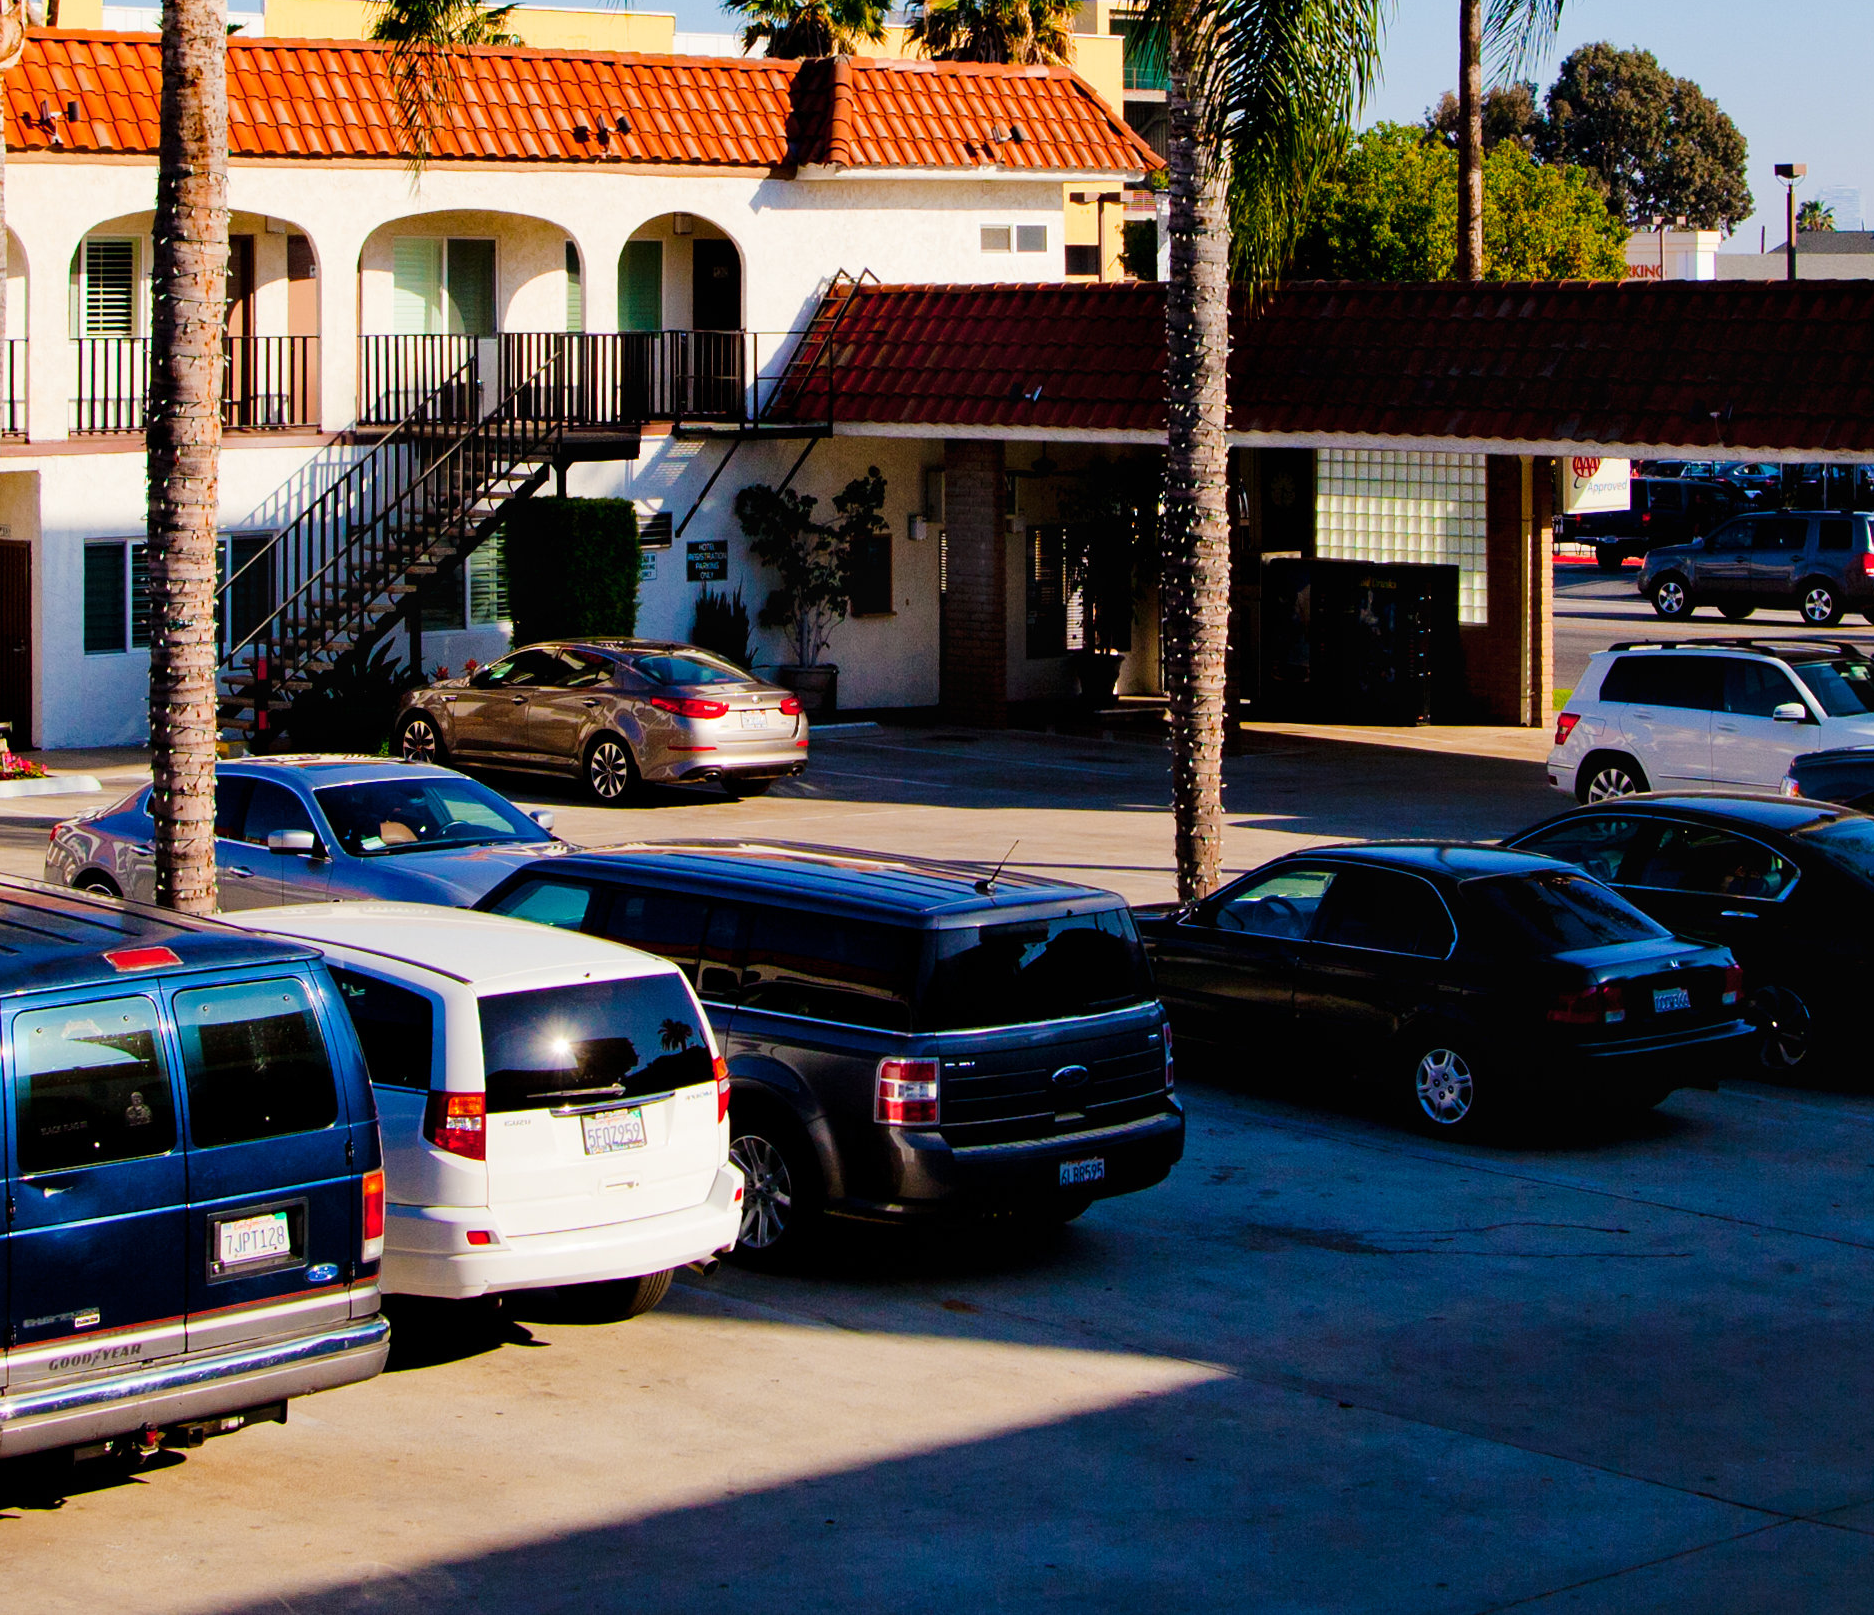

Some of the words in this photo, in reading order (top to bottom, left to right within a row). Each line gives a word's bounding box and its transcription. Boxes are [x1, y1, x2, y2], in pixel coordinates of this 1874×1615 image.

[1587, 478, 1628, 495] Approved
[687, 552, 727, 561] REGISTRATION
[695, 561, 720, 570] PARKING
[224, 1224, 286, 1255] 7JPT128
